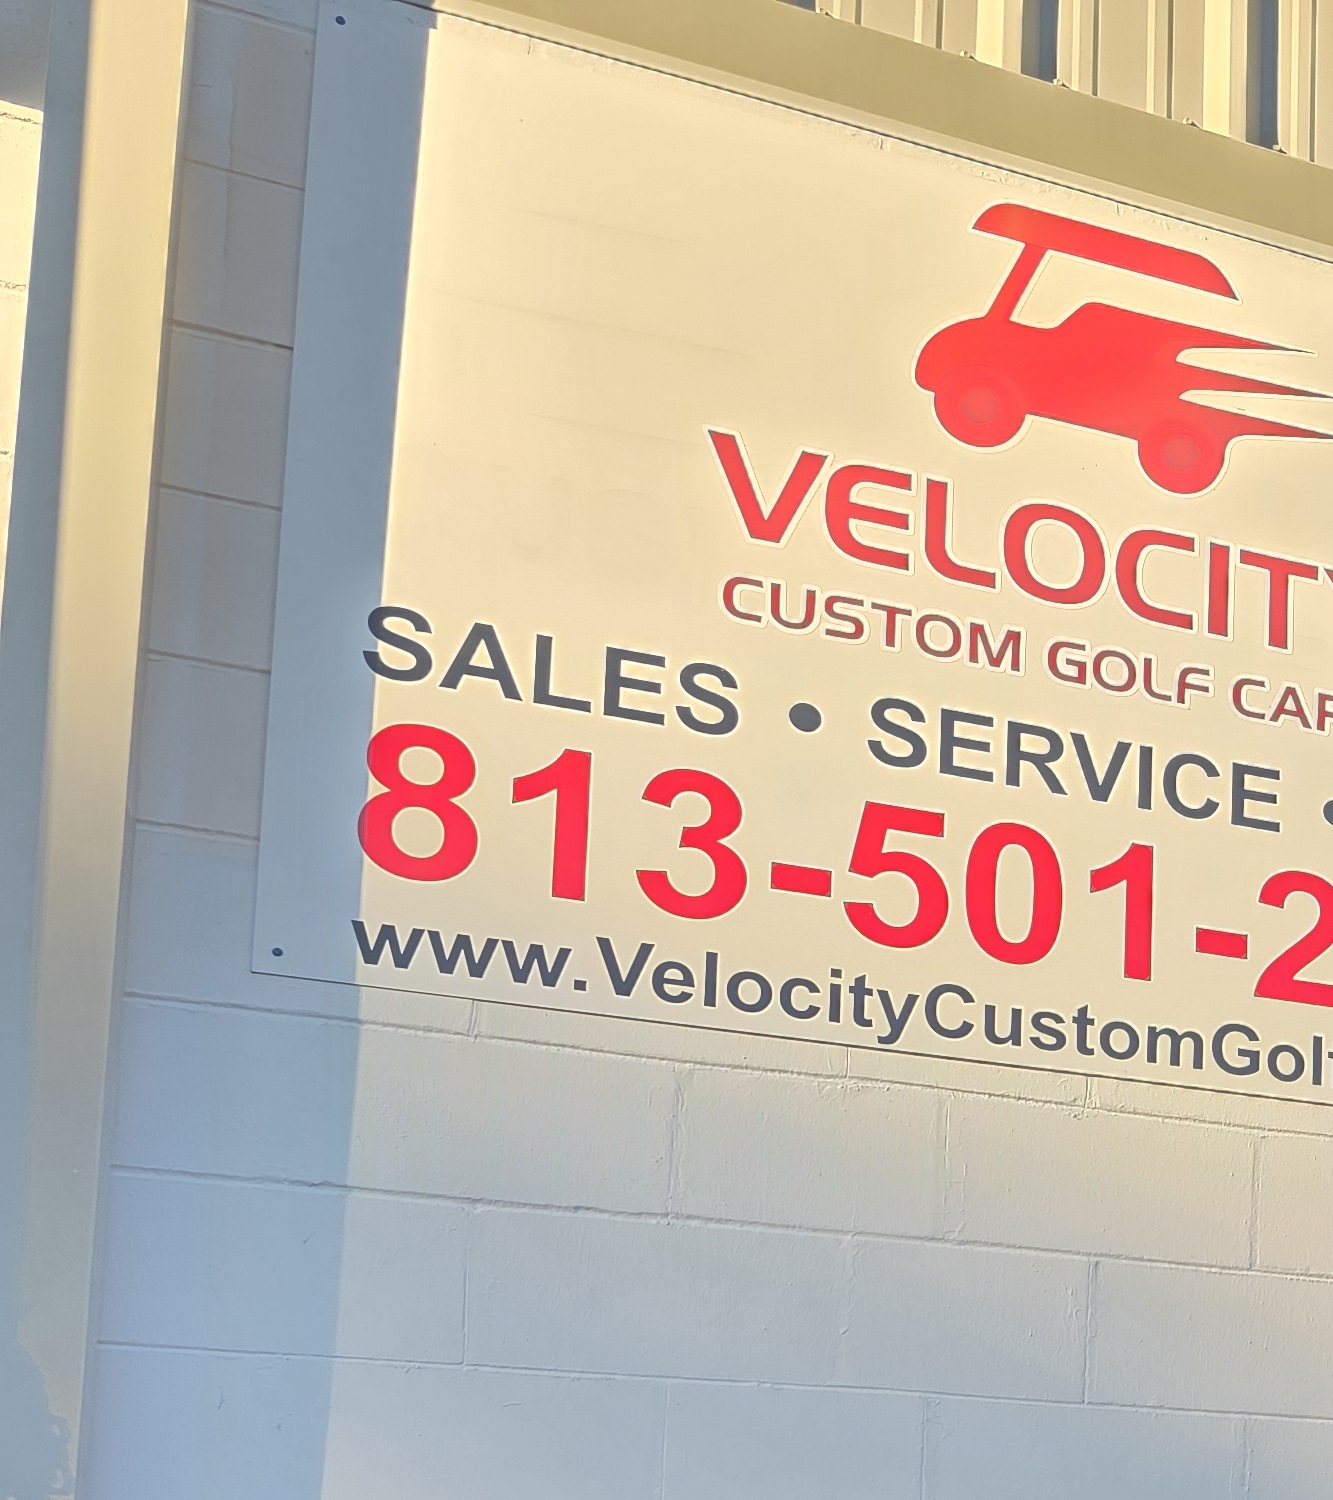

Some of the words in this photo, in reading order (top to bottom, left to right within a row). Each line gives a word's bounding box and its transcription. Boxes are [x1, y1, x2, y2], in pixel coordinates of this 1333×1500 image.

[361, 605, 740, 736] SALES
[866, 697, 1282, 833] SERVICE
[721, 576, 1022, 674] CUSTOM
[1046, 640, 1211, 706] GOLF
